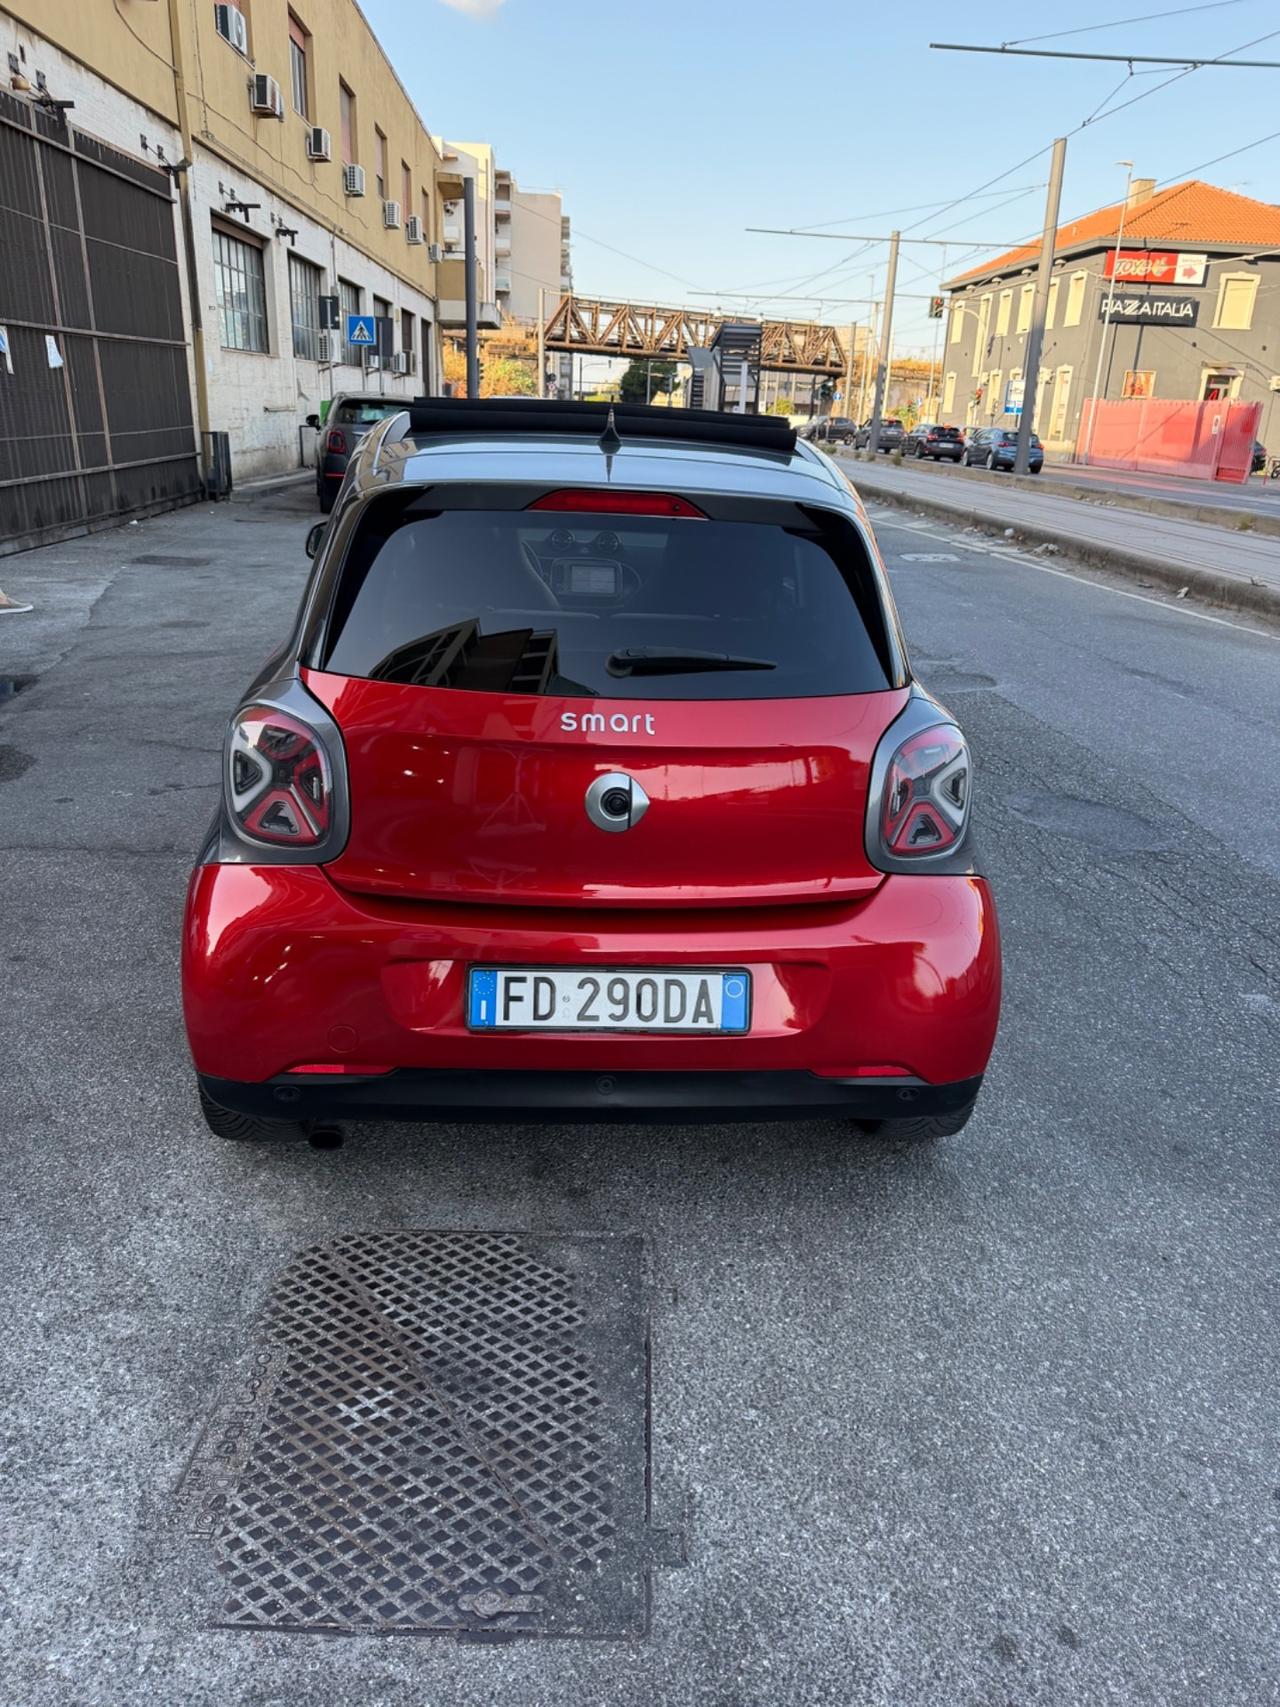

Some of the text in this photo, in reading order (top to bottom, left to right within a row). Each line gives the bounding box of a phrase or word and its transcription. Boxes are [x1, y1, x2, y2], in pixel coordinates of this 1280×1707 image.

[1152, 302, 1194, 318] ITALIA
[560, 712, 656, 736] smart
[503, 976, 557, 1022] FD
[576, 977, 715, 1024] 290DA
